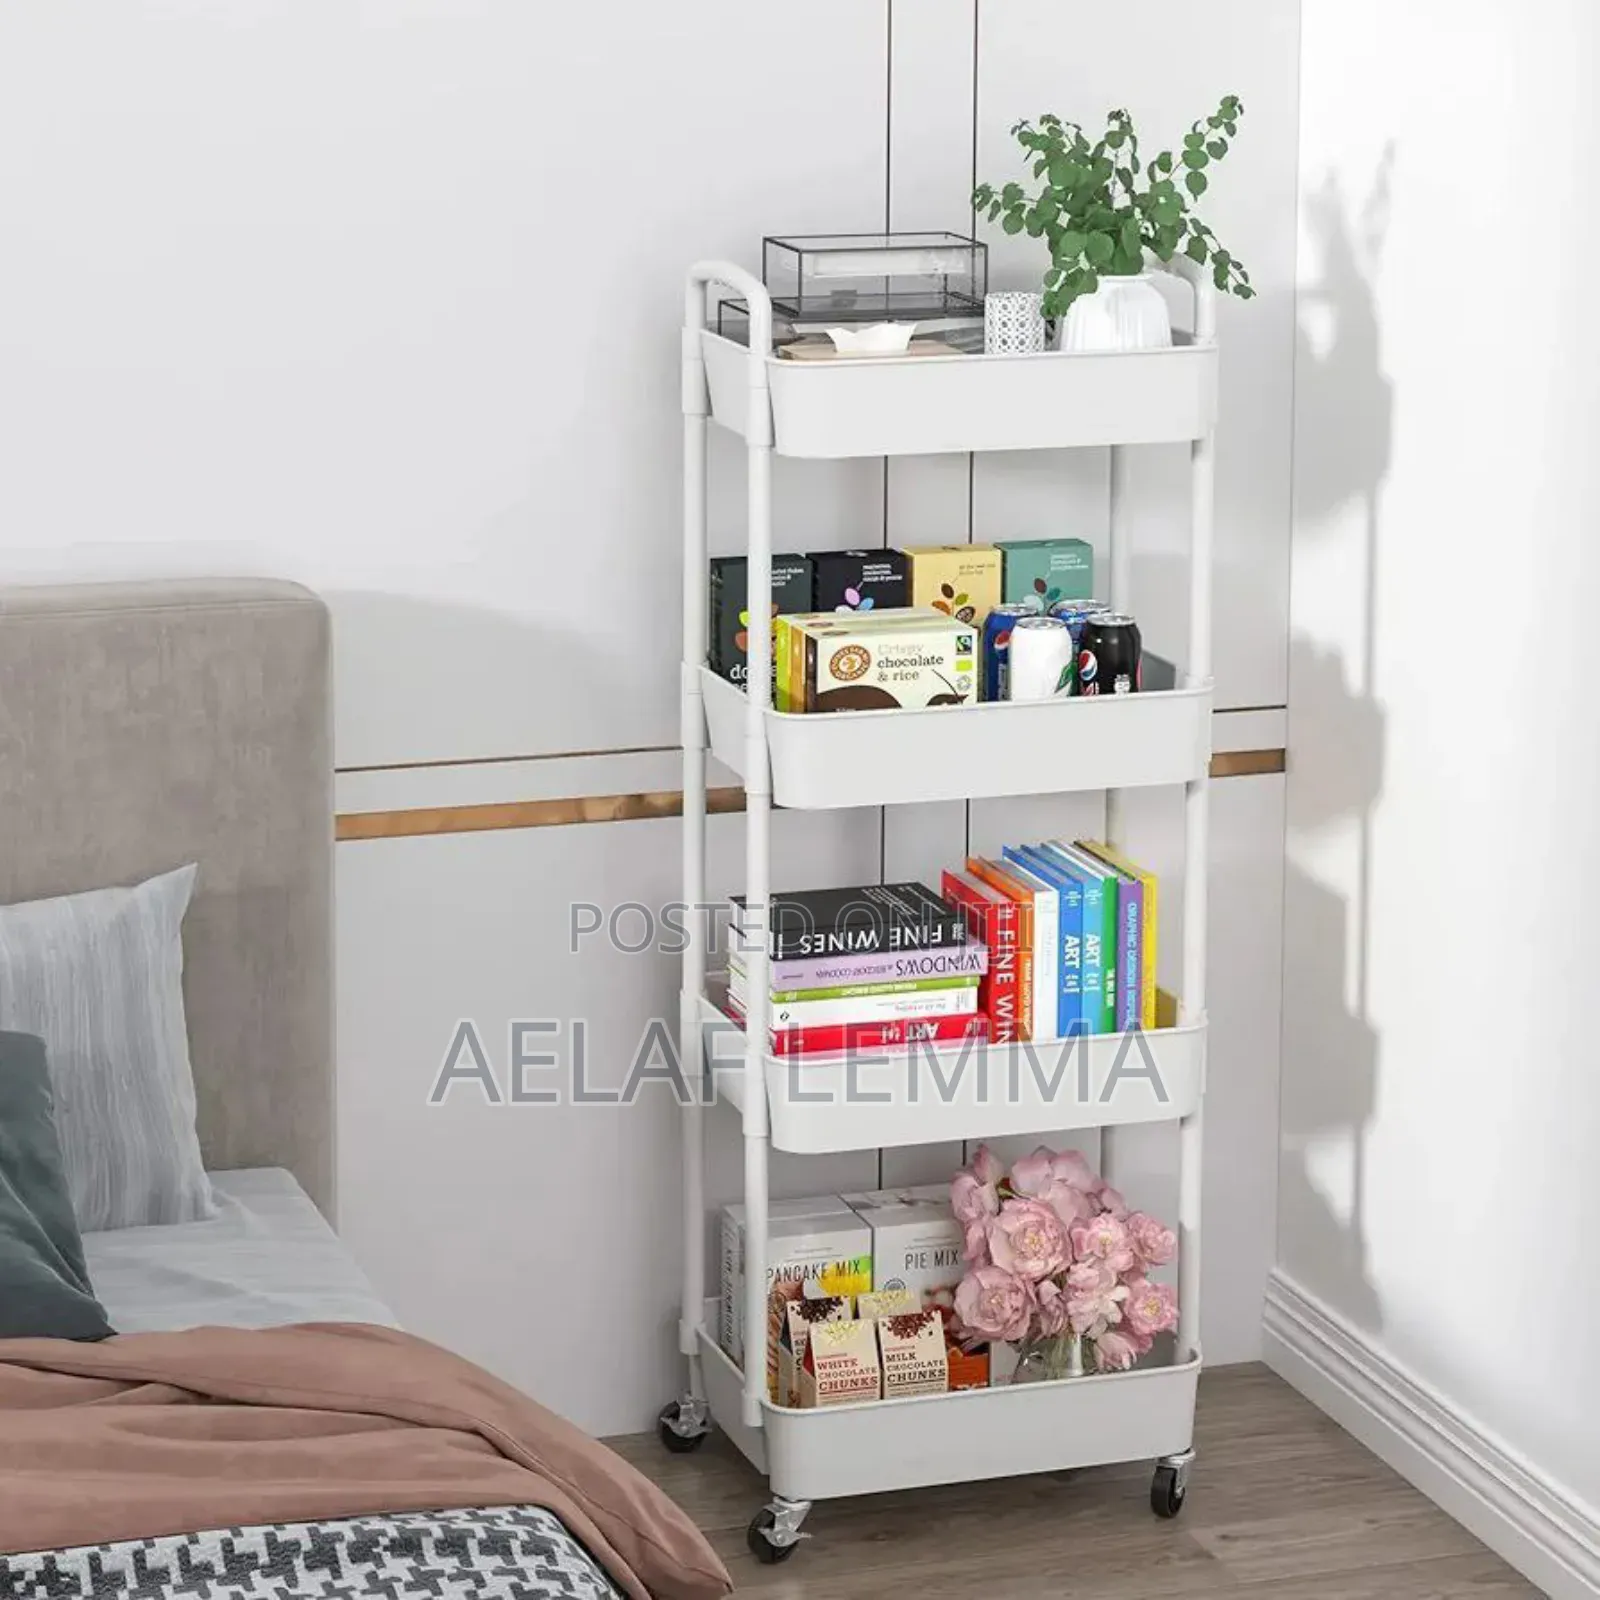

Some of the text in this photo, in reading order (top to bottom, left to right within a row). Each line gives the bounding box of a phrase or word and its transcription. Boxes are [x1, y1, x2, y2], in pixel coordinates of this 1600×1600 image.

[877, 654, 944, 669] chocolate
[877, 669, 920, 682] & rice
[800, 929, 880, 955] WINES
[889, 923, 943, 946] FINE
[996, 929, 1016, 985] FINE
[1063, 934, 1080, 969] ART
[1085, 933, 1101, 967] ART
[895, 953, 981, 976] WINDOWS
[906, 1022, 938, 1040] ART
[905, 1249, 960, 1271] PIE MIX
[767, 1259, 861, 1284] PANCAKE MIX
[816, 1357, 859, 1371] WHITE
[885, 1351, 917, 1363] MILK
[886, 1359, 945, 1372] CHOCOLATE
[818, 1366, 878, 1381] CHOCOLATE
[887, 1369, 946, 1383] CHUNKS
[818, 1376, 879, 1392] CHUNKS
